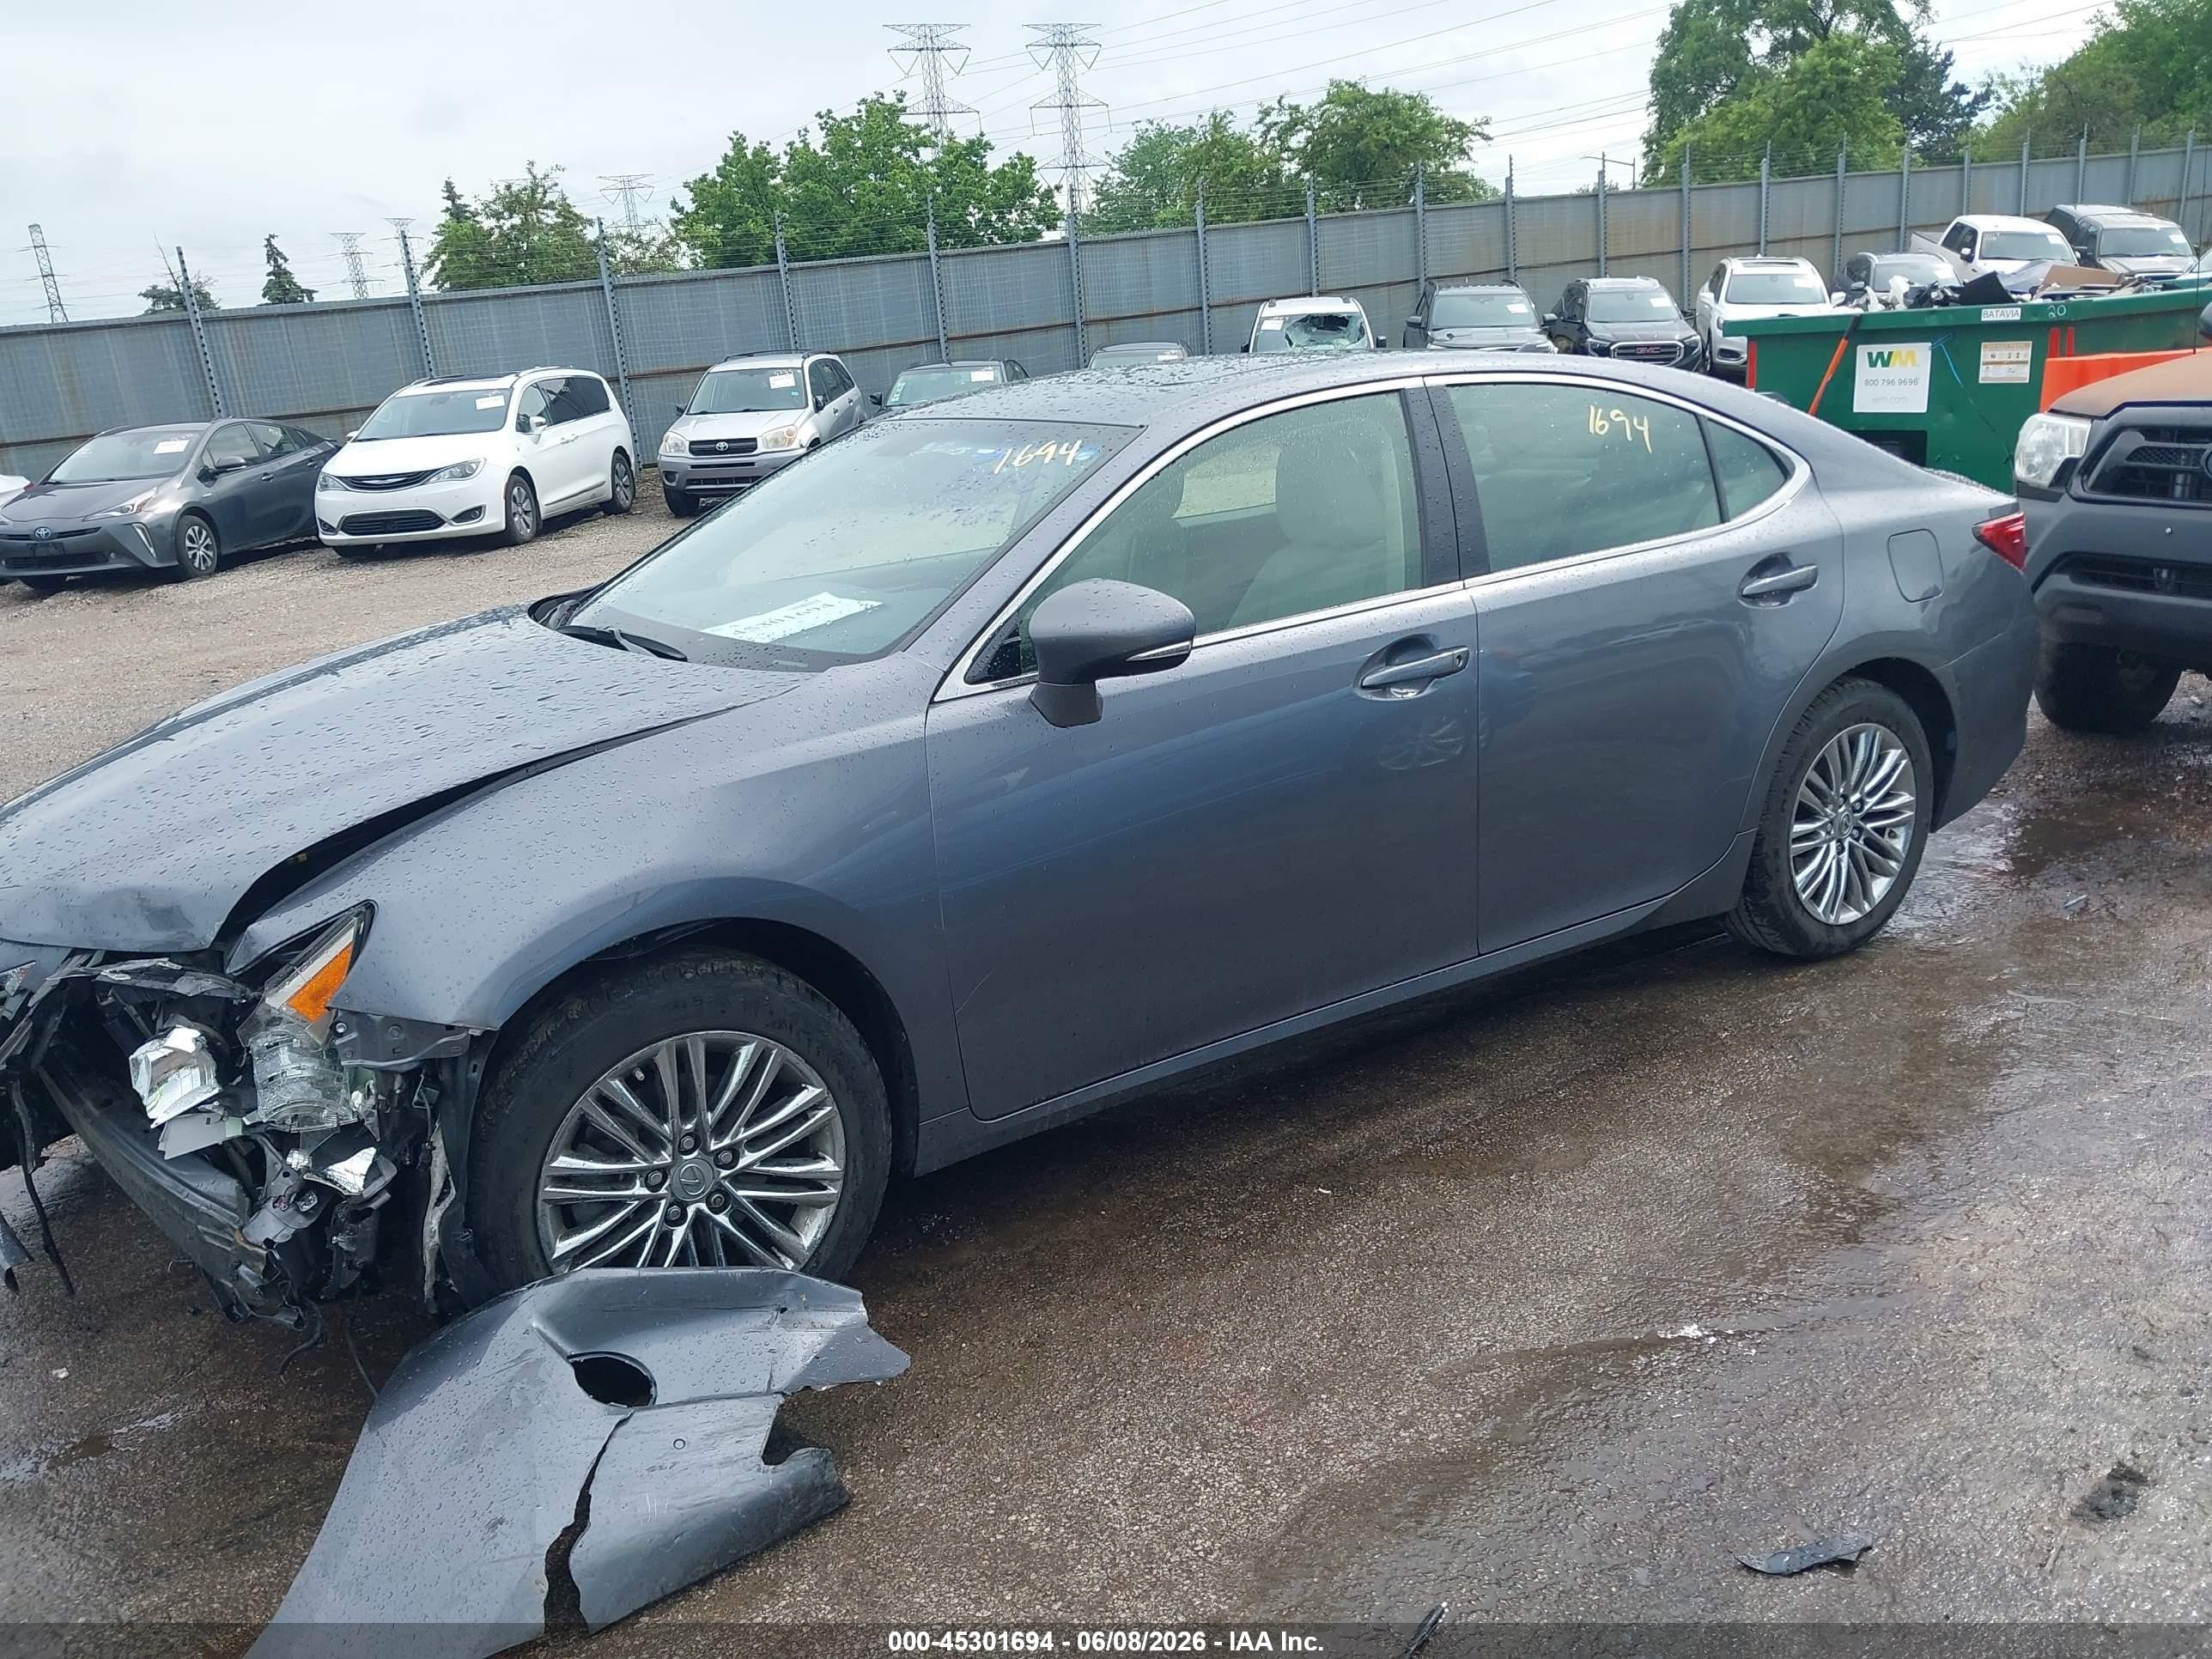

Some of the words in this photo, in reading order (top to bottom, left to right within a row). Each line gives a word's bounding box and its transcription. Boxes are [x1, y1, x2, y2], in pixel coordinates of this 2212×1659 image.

[1983, 310, 2020, 319] BATAVIA
[2046, 304, 2067, 319] 20
[1867, 349, 1917, 368] WM
[1898, 378, 1918, 386] 9696
[1588, 404, 1652, 453] 1694
[994, 440, 1083, 474] 1694
